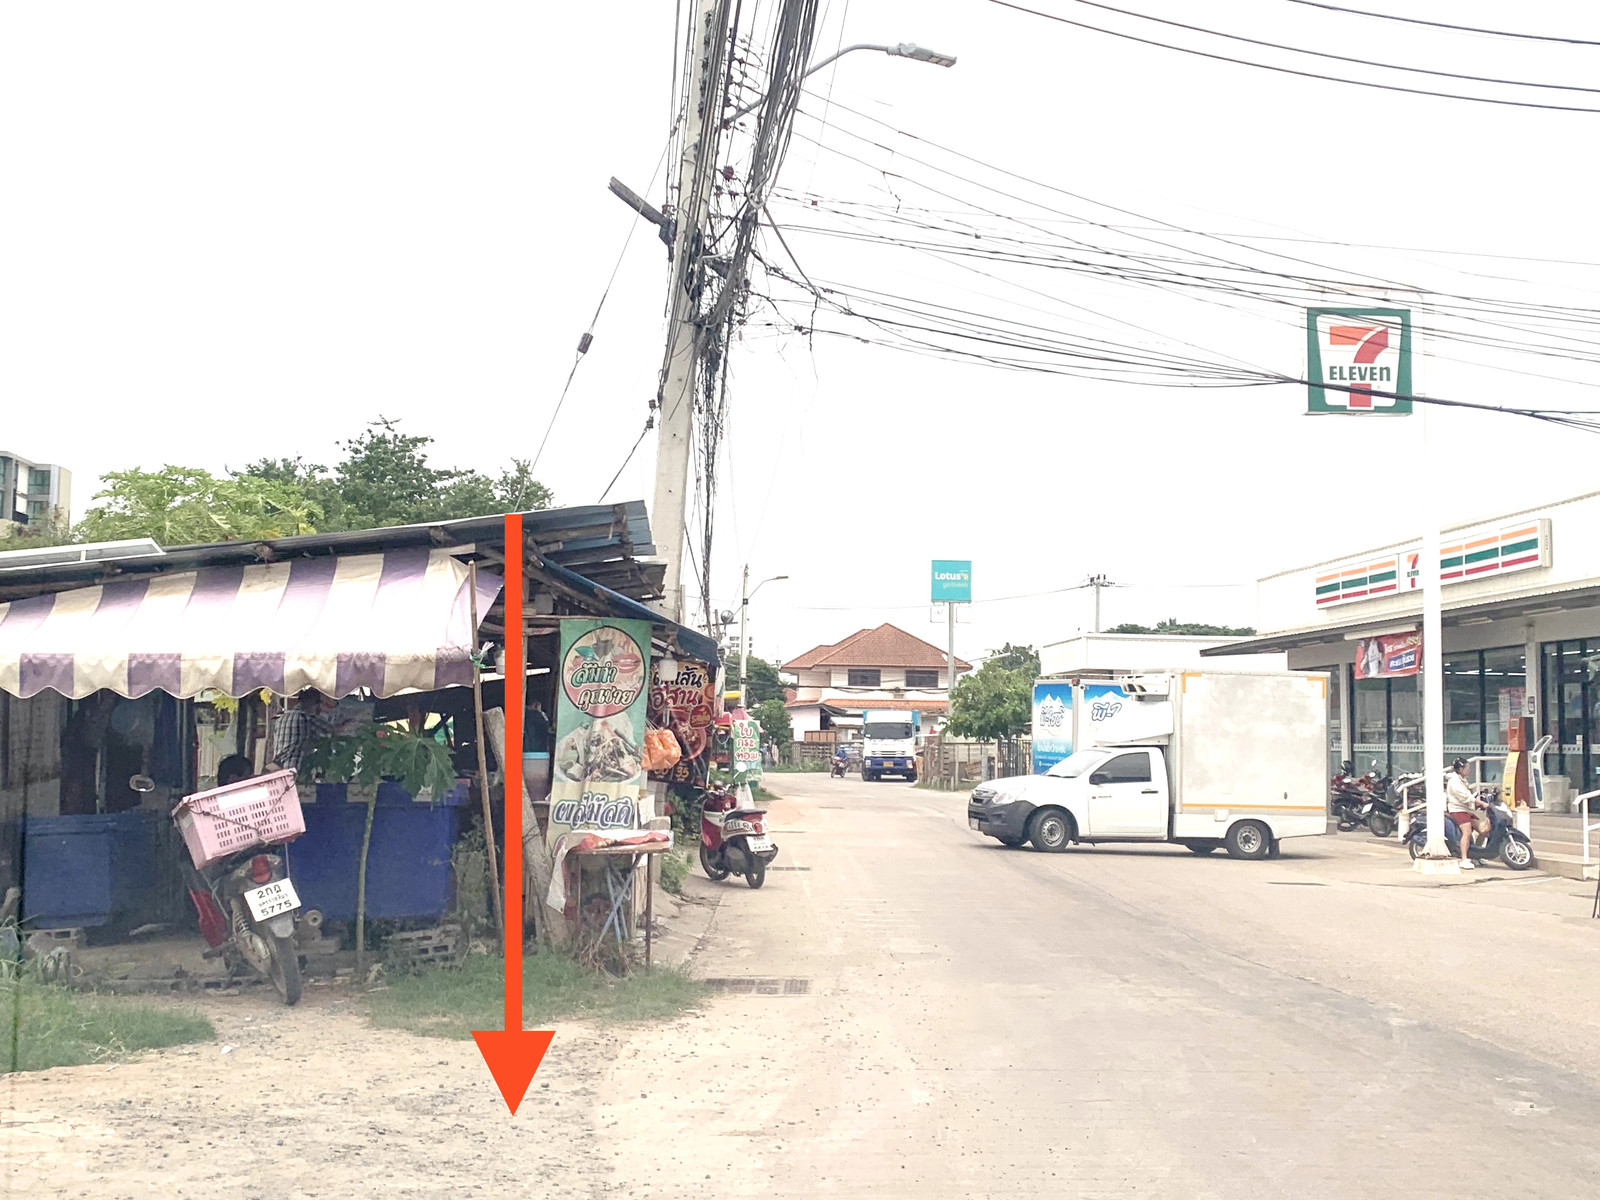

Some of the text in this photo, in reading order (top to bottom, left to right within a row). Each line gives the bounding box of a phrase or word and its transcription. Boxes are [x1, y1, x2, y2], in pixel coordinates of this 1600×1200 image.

[1329, 325, 1389, 408] 7
[739, 722, 753, 737] ใบ
[676, 766, 689, 778] 35
[260, 899, 292, 916] 5775
